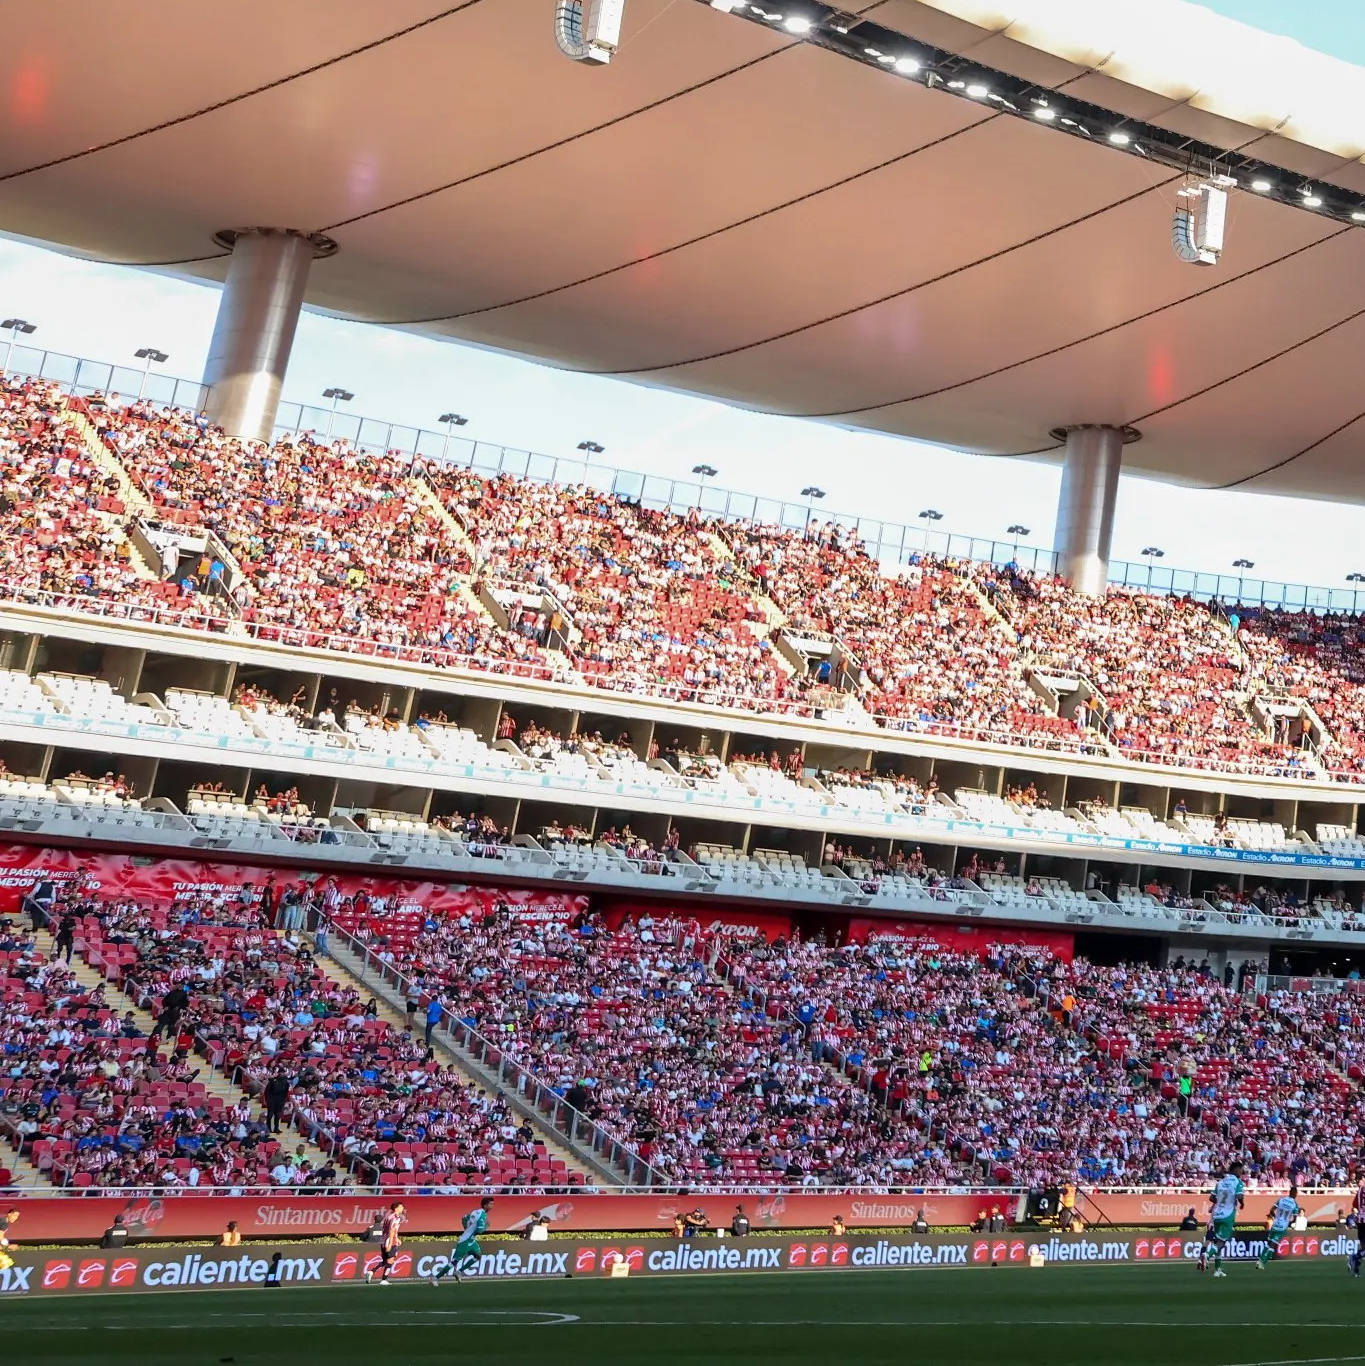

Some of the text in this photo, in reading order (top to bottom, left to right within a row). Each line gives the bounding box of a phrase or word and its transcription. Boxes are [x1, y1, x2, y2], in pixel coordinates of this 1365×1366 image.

[1188, 846, 1237, 858] Estadio AKRON
[1243, 851, 1295, 863] Estadio AKRON
[1302, 856, 1355, 867] Estadio AKRON
[9, 866, 48, 877] PASIÓN
[186, 881, 223, 891] PASIÓN
[254, 1205, 342, 1225] Sintamos
[850, 1201, 914, 1219] Sintamos
[648, 1244, 782, 1270] caliente.mx
[852, 1240, 968, 1265] caliente.mx
[143, 1254, 324, 1286] caliente.mx
